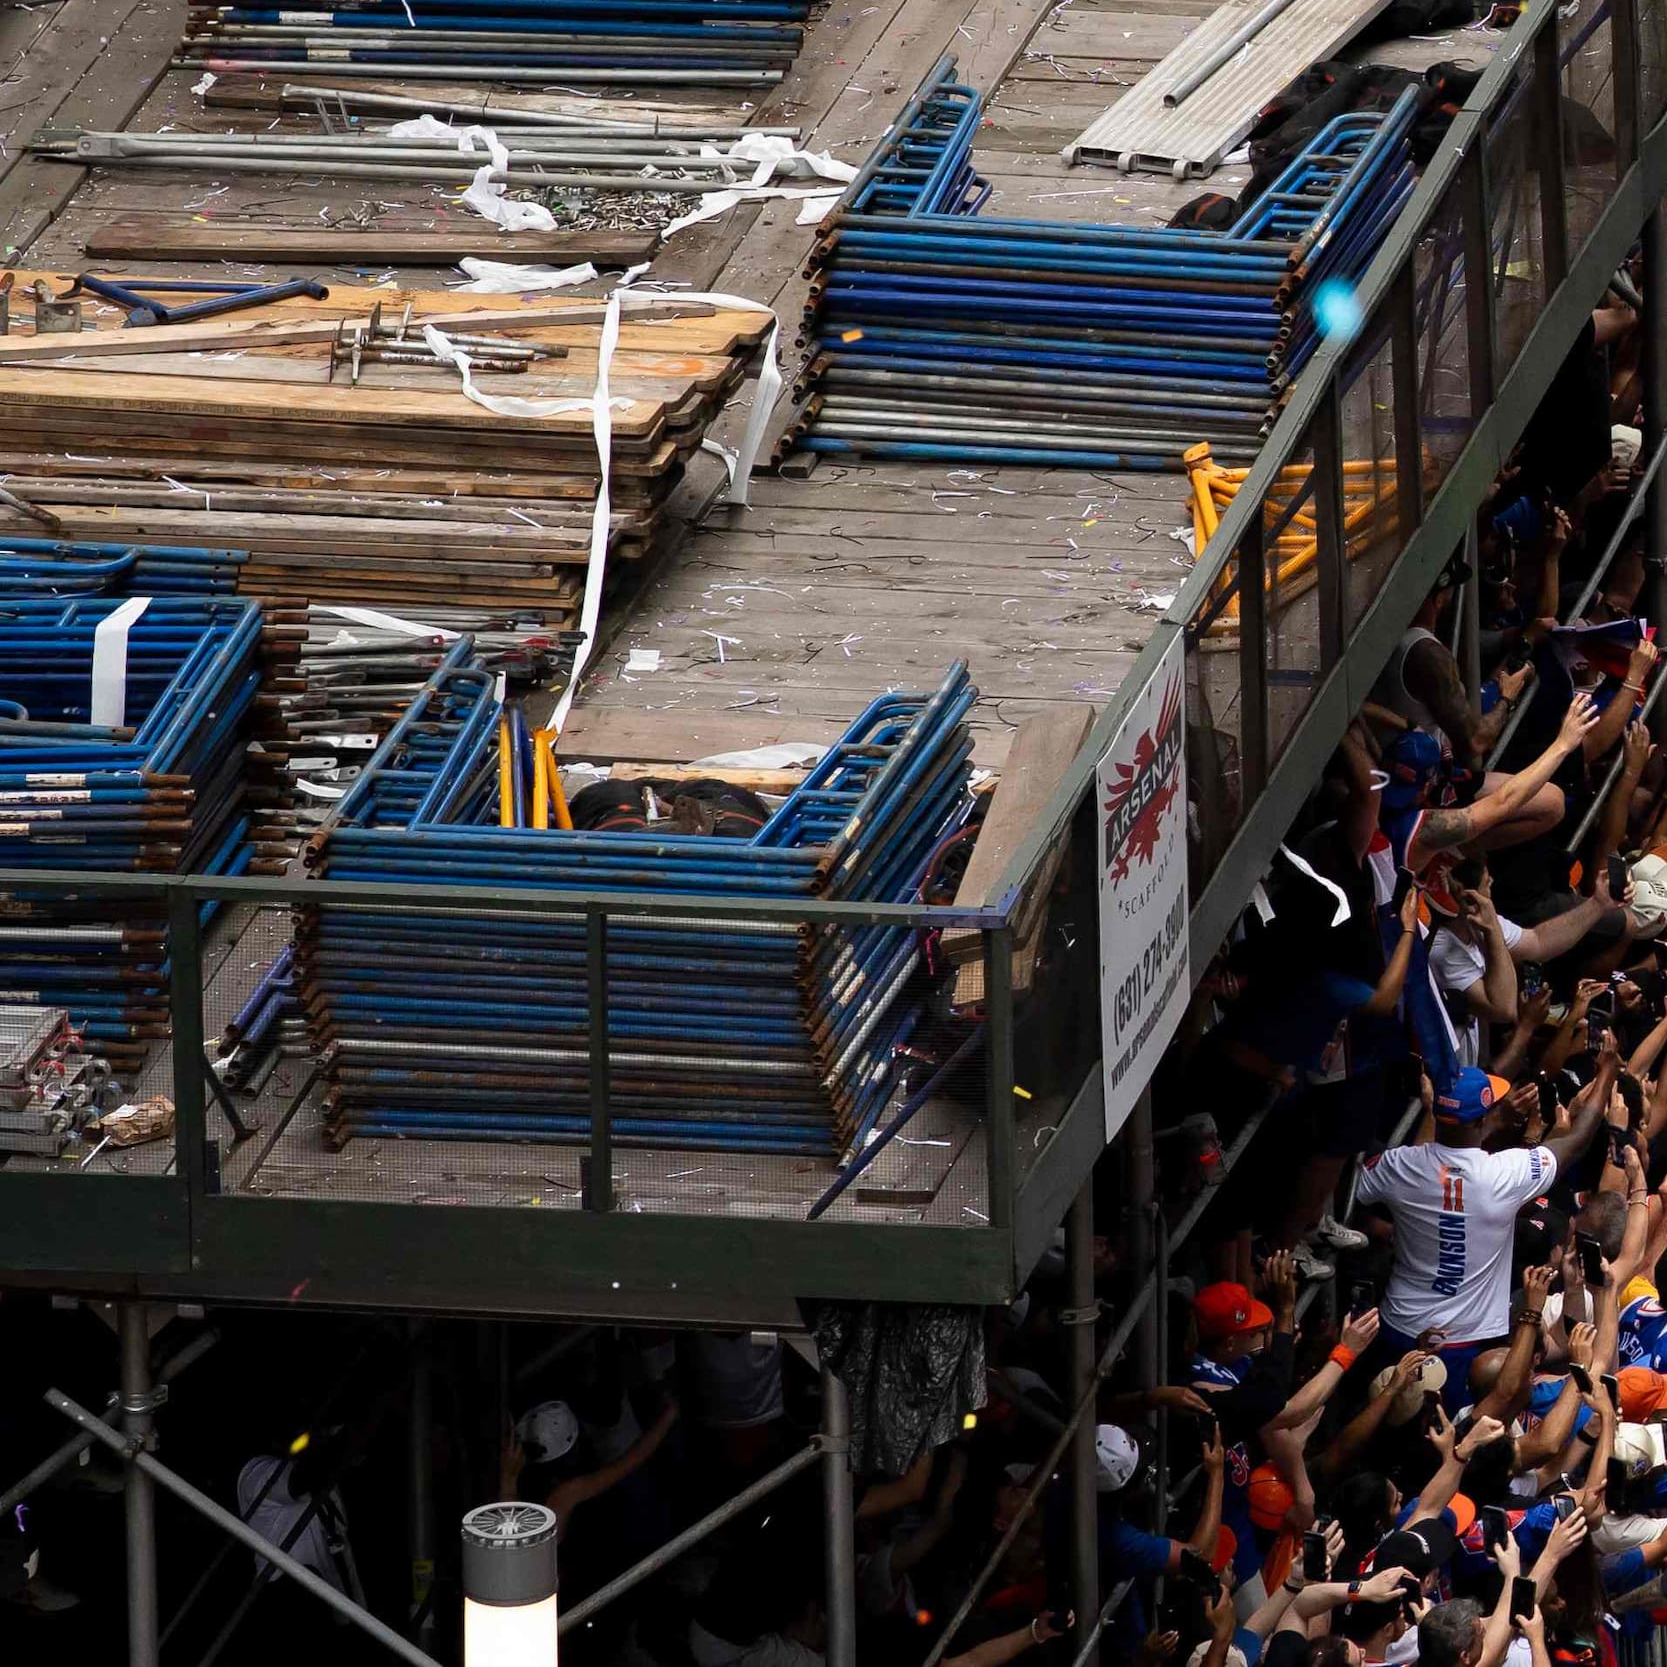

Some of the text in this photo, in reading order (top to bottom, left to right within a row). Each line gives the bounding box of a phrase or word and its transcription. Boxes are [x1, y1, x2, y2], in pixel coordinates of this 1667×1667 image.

[1108, 734, 1181, 858] ARSENAL
[1112, 962, 1142, 1048] (631)
[1442, 1177, 1464, 1214] 11
[1431, 1213, 1466, 1296] BRUNSON
